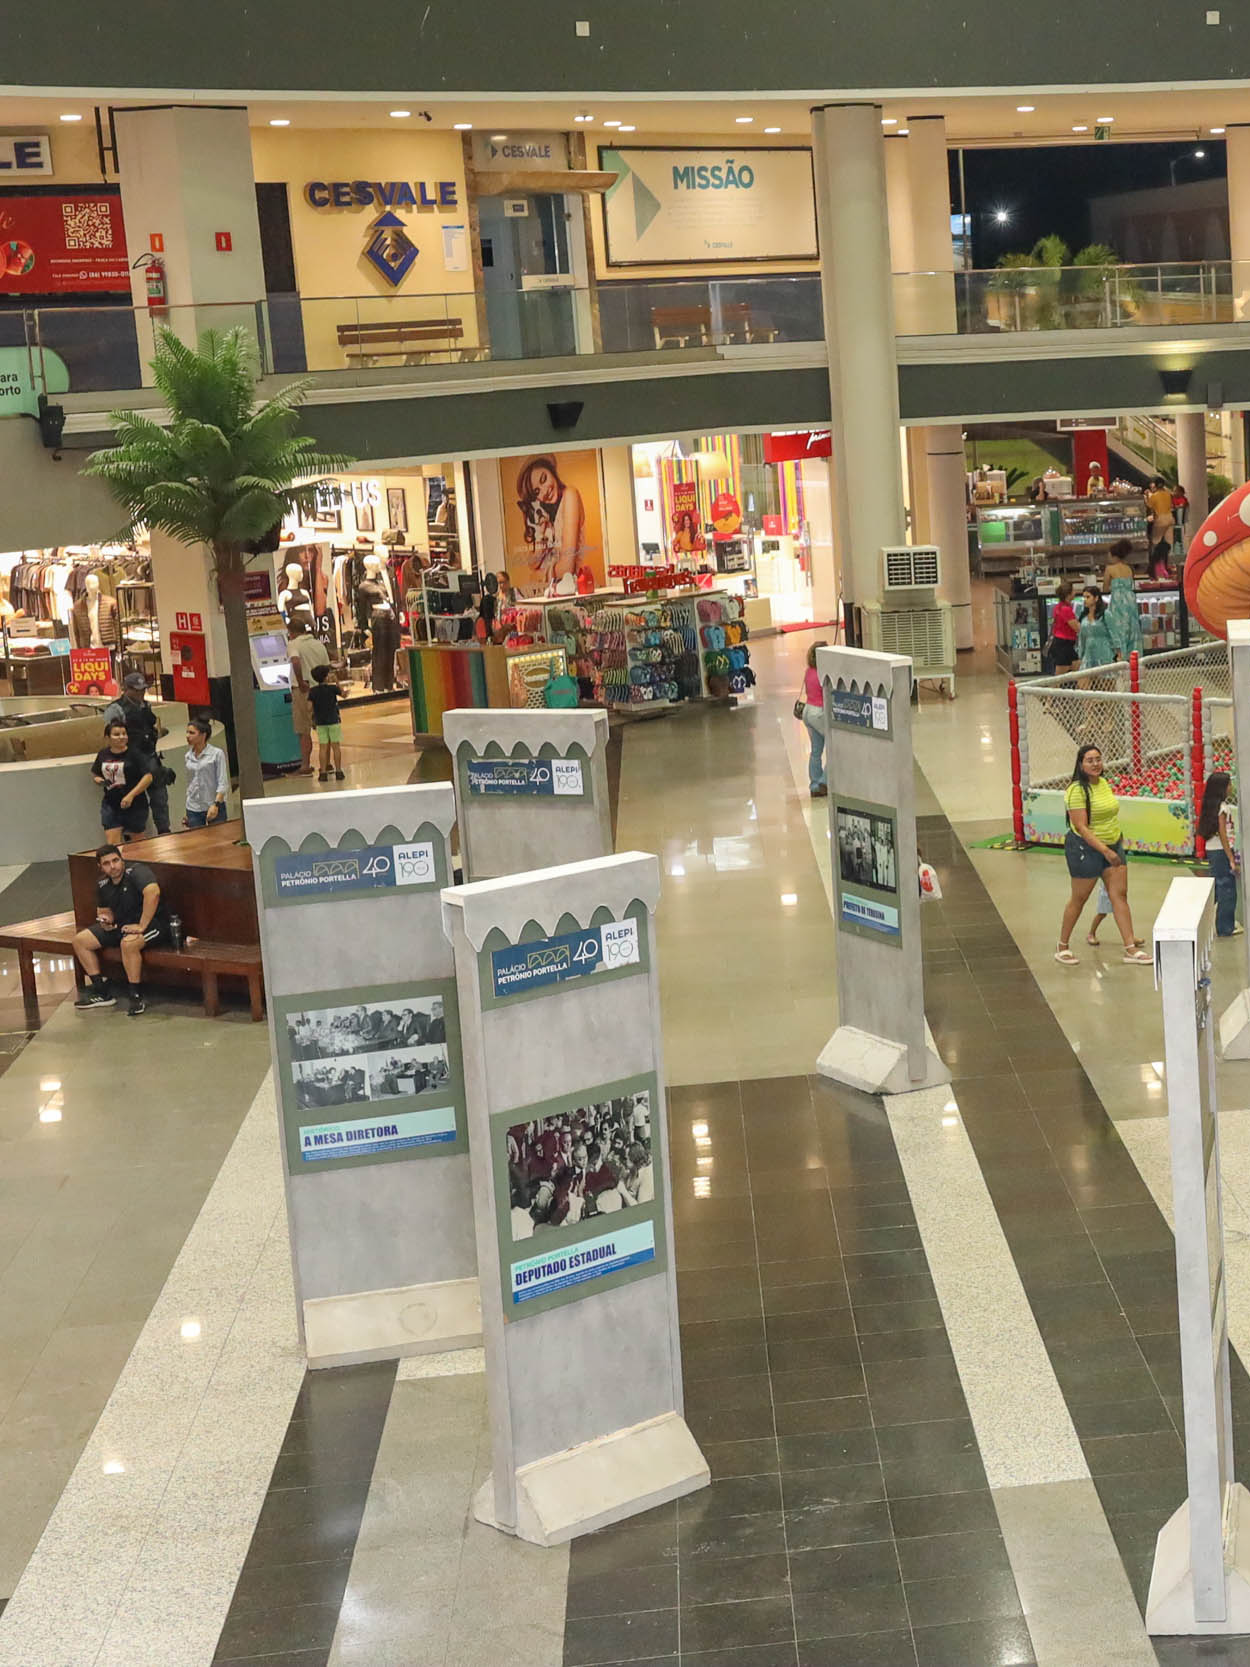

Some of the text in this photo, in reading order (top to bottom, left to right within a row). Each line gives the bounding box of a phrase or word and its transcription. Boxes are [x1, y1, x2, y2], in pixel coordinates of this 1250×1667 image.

[502, 145, 551, 158] CESVALE
[672, 159, 754, 190] MISSÃO
[308, 181, 458, 207] CESVALE
[73, 661, 109, 672] LIQUI
[74, 672, 106, 681] DAYS
[529, 767, 550, 786] 40
[555, 766, 578, 774] ALEPI
[398, 850, 429, 861] ALEPI
[362, 856, 391, 877] 40
[281, 874, 357, 888] PETRÔNIO PORTELLA
[605, 927, 633, 941] ALEPI
[573, 939, 598, 964] 40
[497, 963, 526, 976] PALÁCIO
[498, 962, 568, 985] PETRÔNIO PORTELLA
[304, 1135, 312, 1147] A
[314, 1131, 344, 1146] MESA
[346, 1124, 398, 1142] DIRETORA
[515, 1261, 567, 1286] DEPUTADO
[569, 1243, 617, 1269] ESTADUAL
